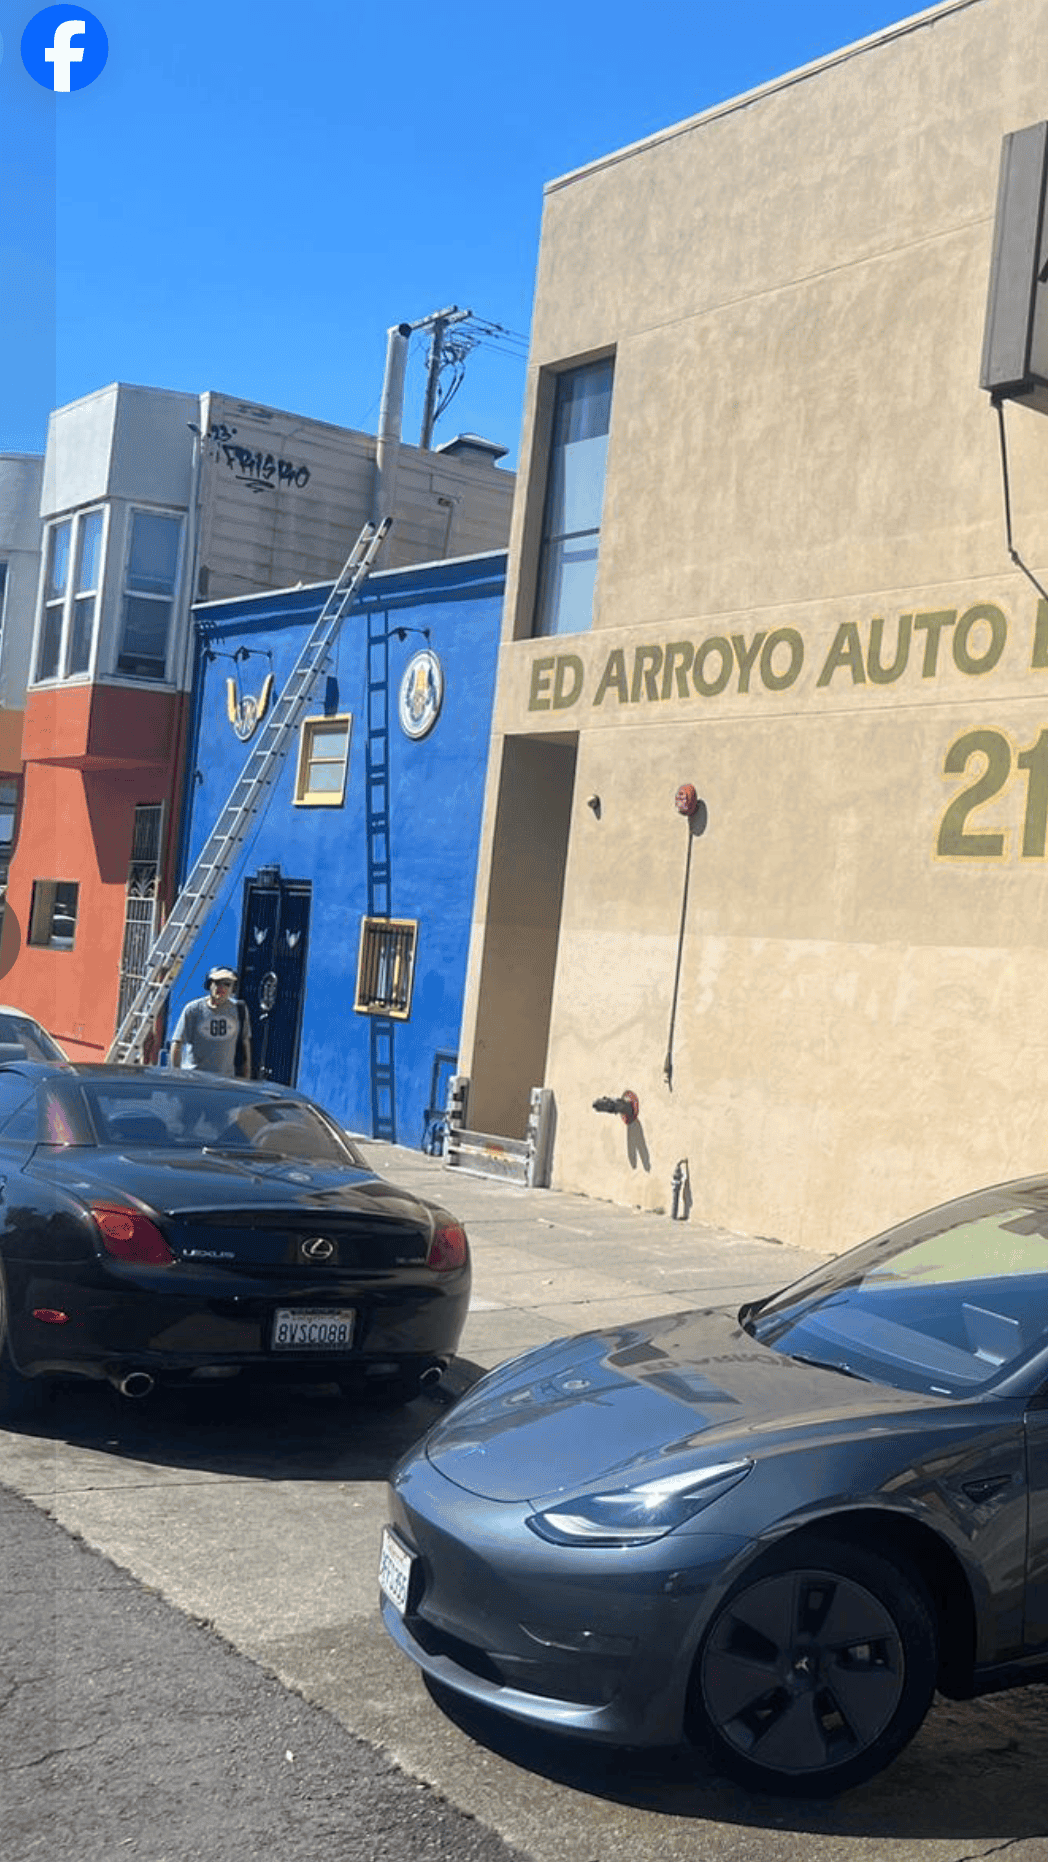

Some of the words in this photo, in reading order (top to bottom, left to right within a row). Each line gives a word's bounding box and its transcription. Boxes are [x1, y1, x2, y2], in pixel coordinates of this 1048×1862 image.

[528, 654, 583, 711] ED
[593, 627, 804, 706] ARROYO
[816, 603, 1007, 687] AUTO
[278, 1323, 347, 1343] 8VSC088
